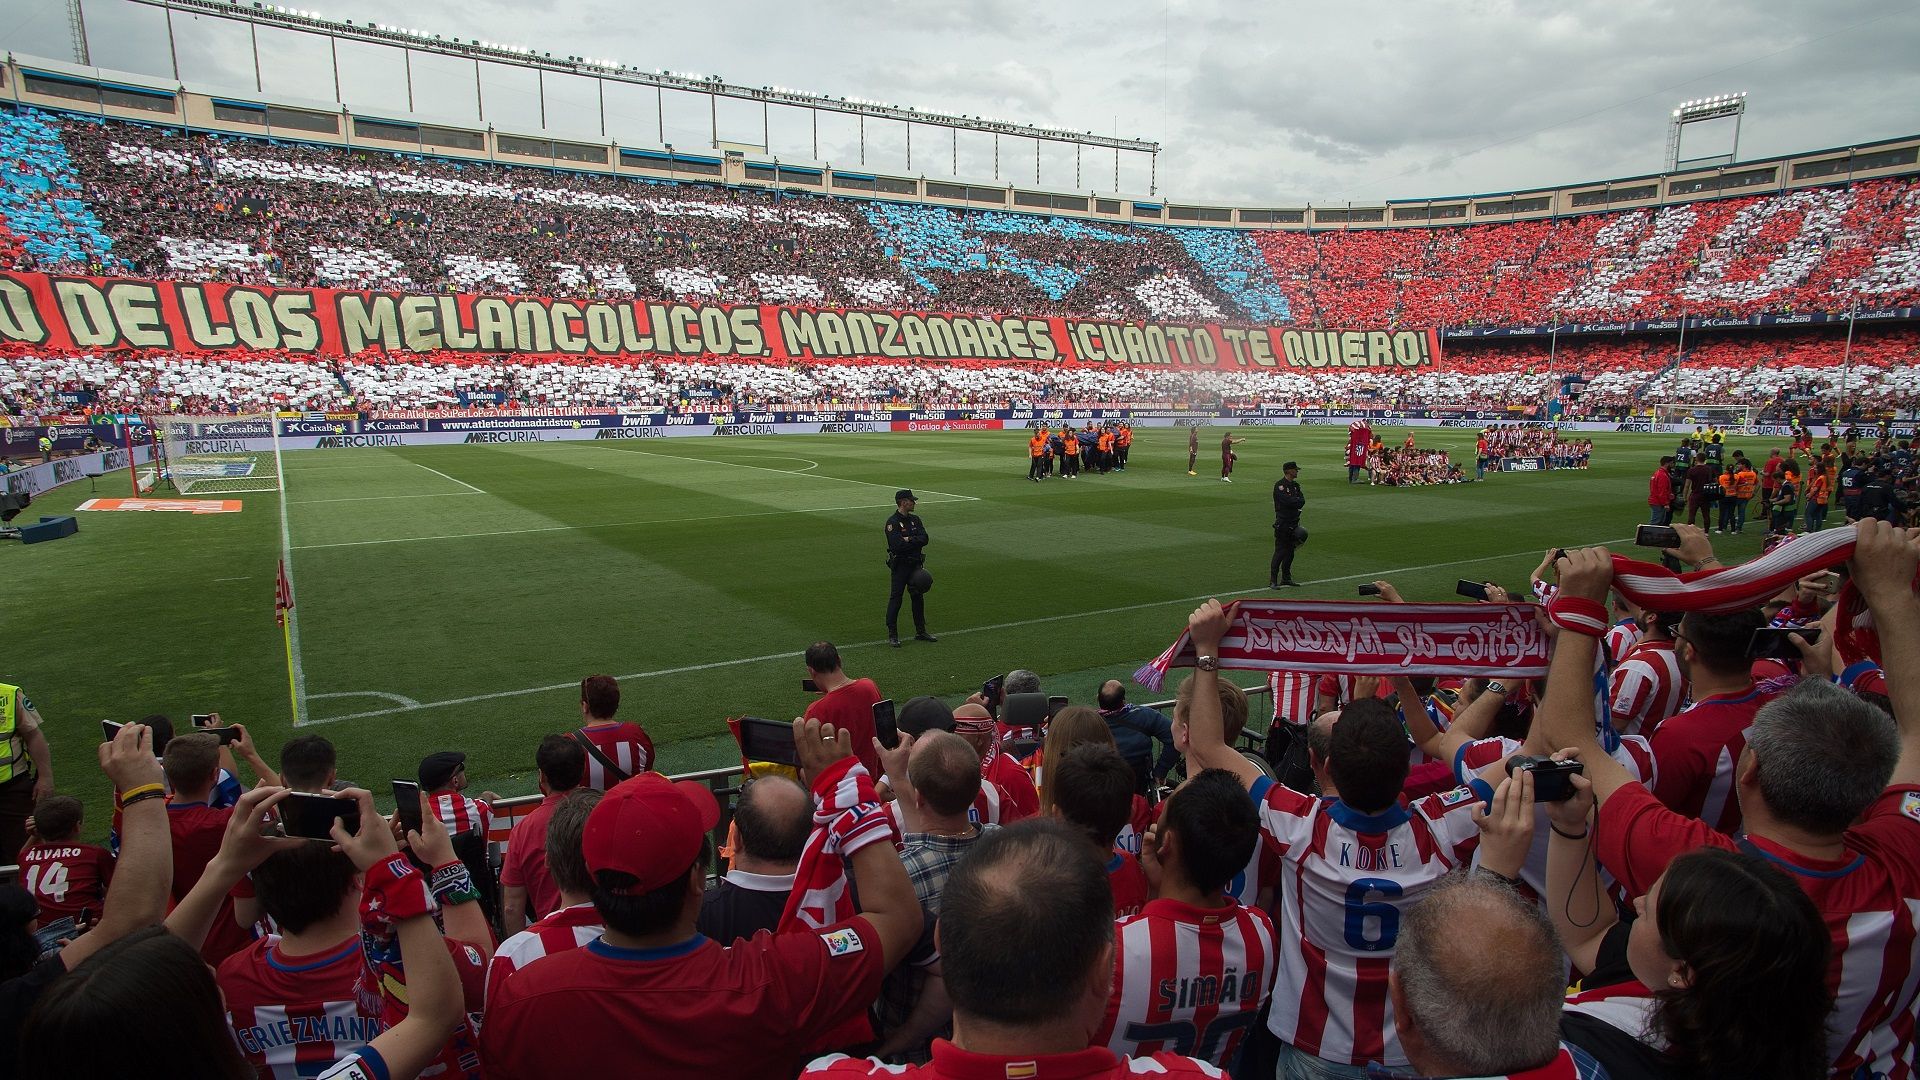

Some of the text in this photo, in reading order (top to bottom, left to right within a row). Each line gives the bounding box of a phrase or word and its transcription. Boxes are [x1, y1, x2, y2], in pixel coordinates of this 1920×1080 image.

[1852, 309, 1896, 321] CaixaBank
[51, 277, 174, 350] DE
[174, 282, 323, 355] LOS
[778, 308, 1068, 364] MANZANARES,
[1222, 325, 1278, 368] TE
[1280, 327, 1438, 369] QUIERO!
[1712, 318, 1750, 327] CaixaBank
[665, 413, 694, 425] bwin
[748, 412, 776, 423] bwin
[796, 414, 837, 423] Plus500
[854, 413, 892, 422] Plus500
[909, 412, 946, 421] Plus500
[1012, 409, 1034, 419] bwin
[1073, 408, 1093, 418] bwin
[1102, 408, 1121, 418] bwin
[377, 419, 420, 432] CaixaBank
[622, 414, 651, 427] bwin
[952, 421, 988, 431] Santander
[1173, 418, 1214, 428] MERCURIAL
[1239, 418, 1276, 426] MERCURIAL
[1300, 418, 1335, 426] MERCURIAL
[595, 427, 667, 440] MERCURIAL
[712, 424, 778, 436] MERCURIAL
[819, 423, 878, 434] MERCURIAL
[316, 433, 406, 449] MERCURIAL
[464, 431, 545, 444] MERCURIAL
[1510, 462, 1538, 471] Plus500
[26, 847, 82, 861] ÁLVARO
[1339, 841, 1403, 871] KOKE
[26, 861, 70, 902] 14
[1344, 877, 1403, 952] 6
[847, 931, 860, 946] LFP
[1159, 966, 1258, 1012] SIMÃO
[239, 1014, 386, 1055] GRIEZMANN
